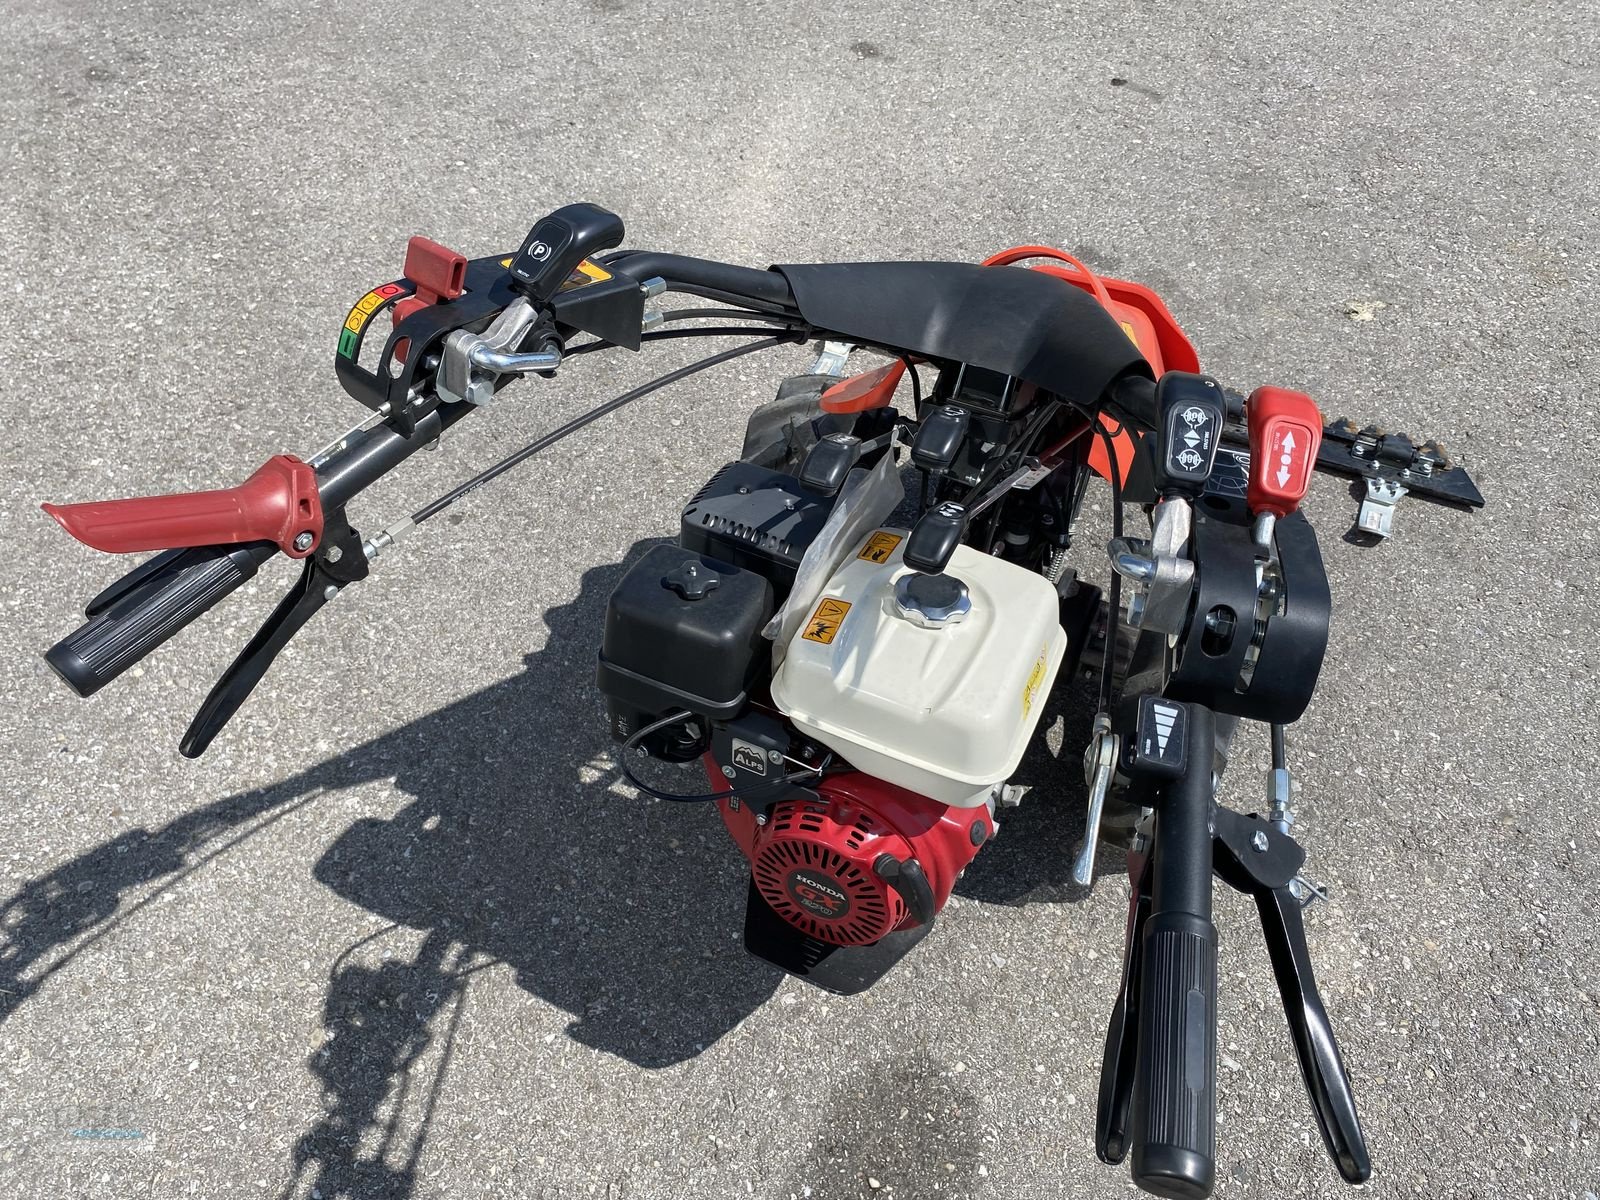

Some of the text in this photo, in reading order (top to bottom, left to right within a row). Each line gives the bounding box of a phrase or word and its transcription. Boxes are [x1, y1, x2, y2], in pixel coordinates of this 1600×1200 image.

[735, 753, 764, 771] ALPS
[795, 874, 846, 901] HONDA
[795, 884, 843, 911] GX
